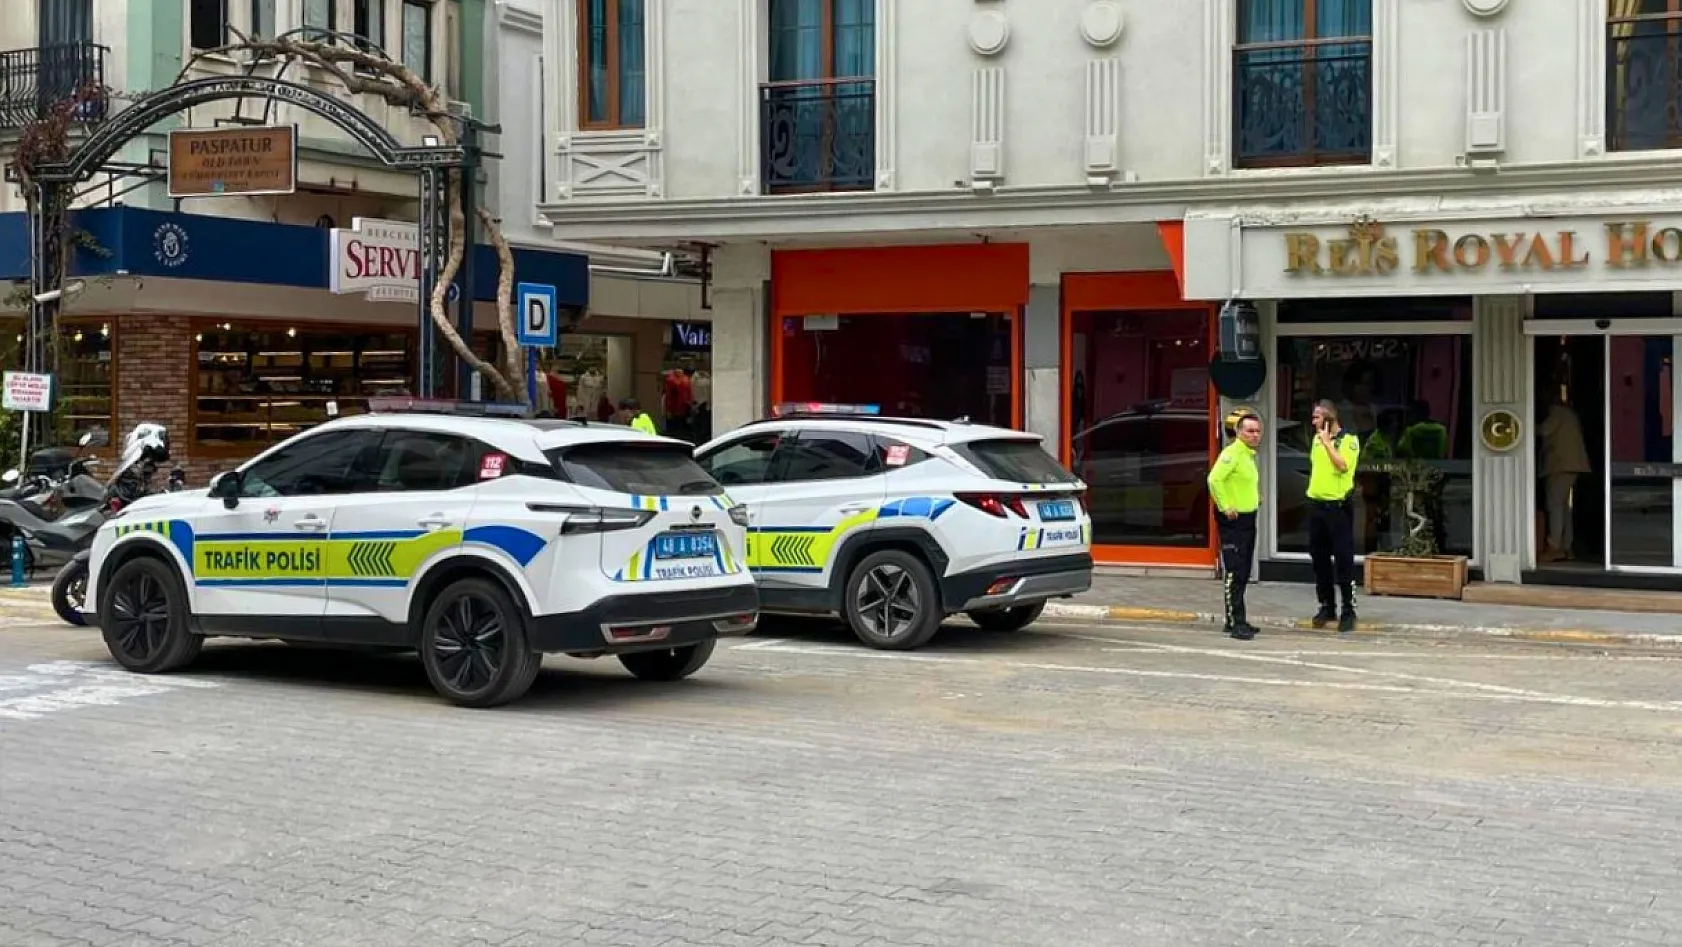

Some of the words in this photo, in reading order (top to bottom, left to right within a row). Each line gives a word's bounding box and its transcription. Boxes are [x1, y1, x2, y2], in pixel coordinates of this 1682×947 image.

[190, 137, 272, 156] PASPATUR
[1411, 228, 1589, 272] ROYAL
[529, 298, 545, 331] D
[662, 537, 674, 553] 48
[203, 546, 261, 571] TRAFİK
[266, 547, 320, 571] POLİSİ
